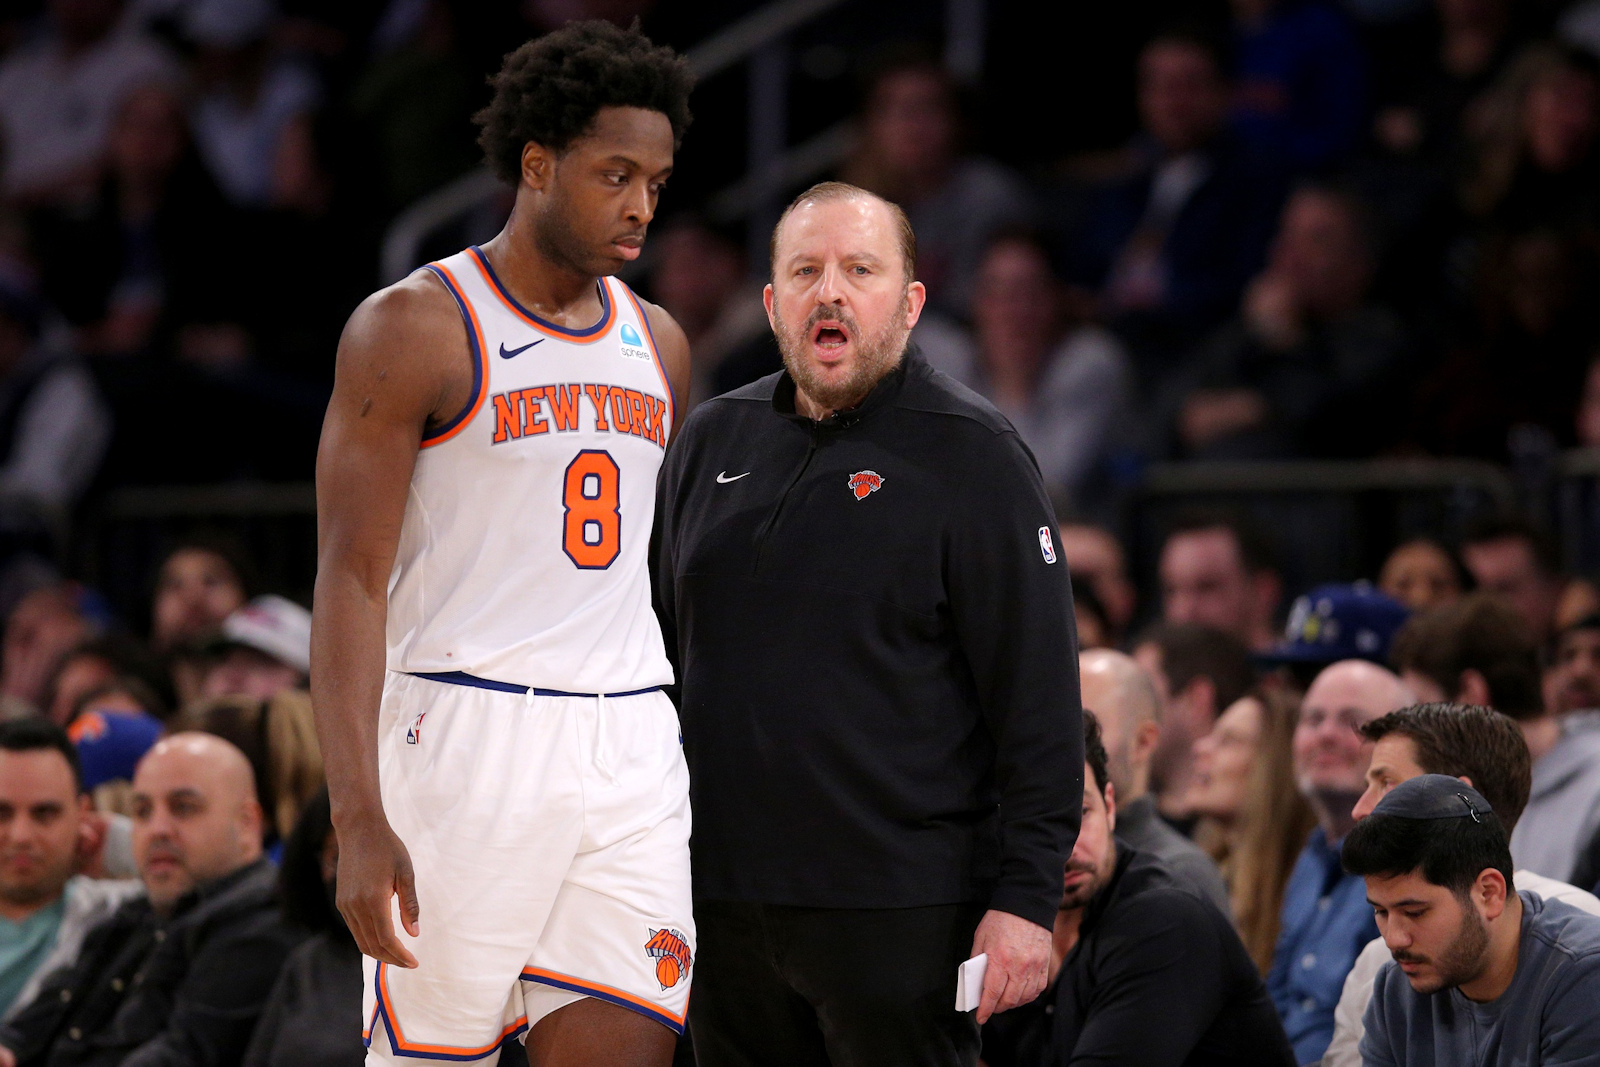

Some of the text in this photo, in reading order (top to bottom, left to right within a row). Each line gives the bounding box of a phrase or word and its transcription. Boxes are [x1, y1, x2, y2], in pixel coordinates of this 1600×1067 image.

[621, 348, 650, 360] sphere
[491, 382, 667, 451] NEW YORK
[850, 473, 880, 488] KNICKS
[562, 449, 621, 570] 8
[644, 929, 691, 976] KNICKS
